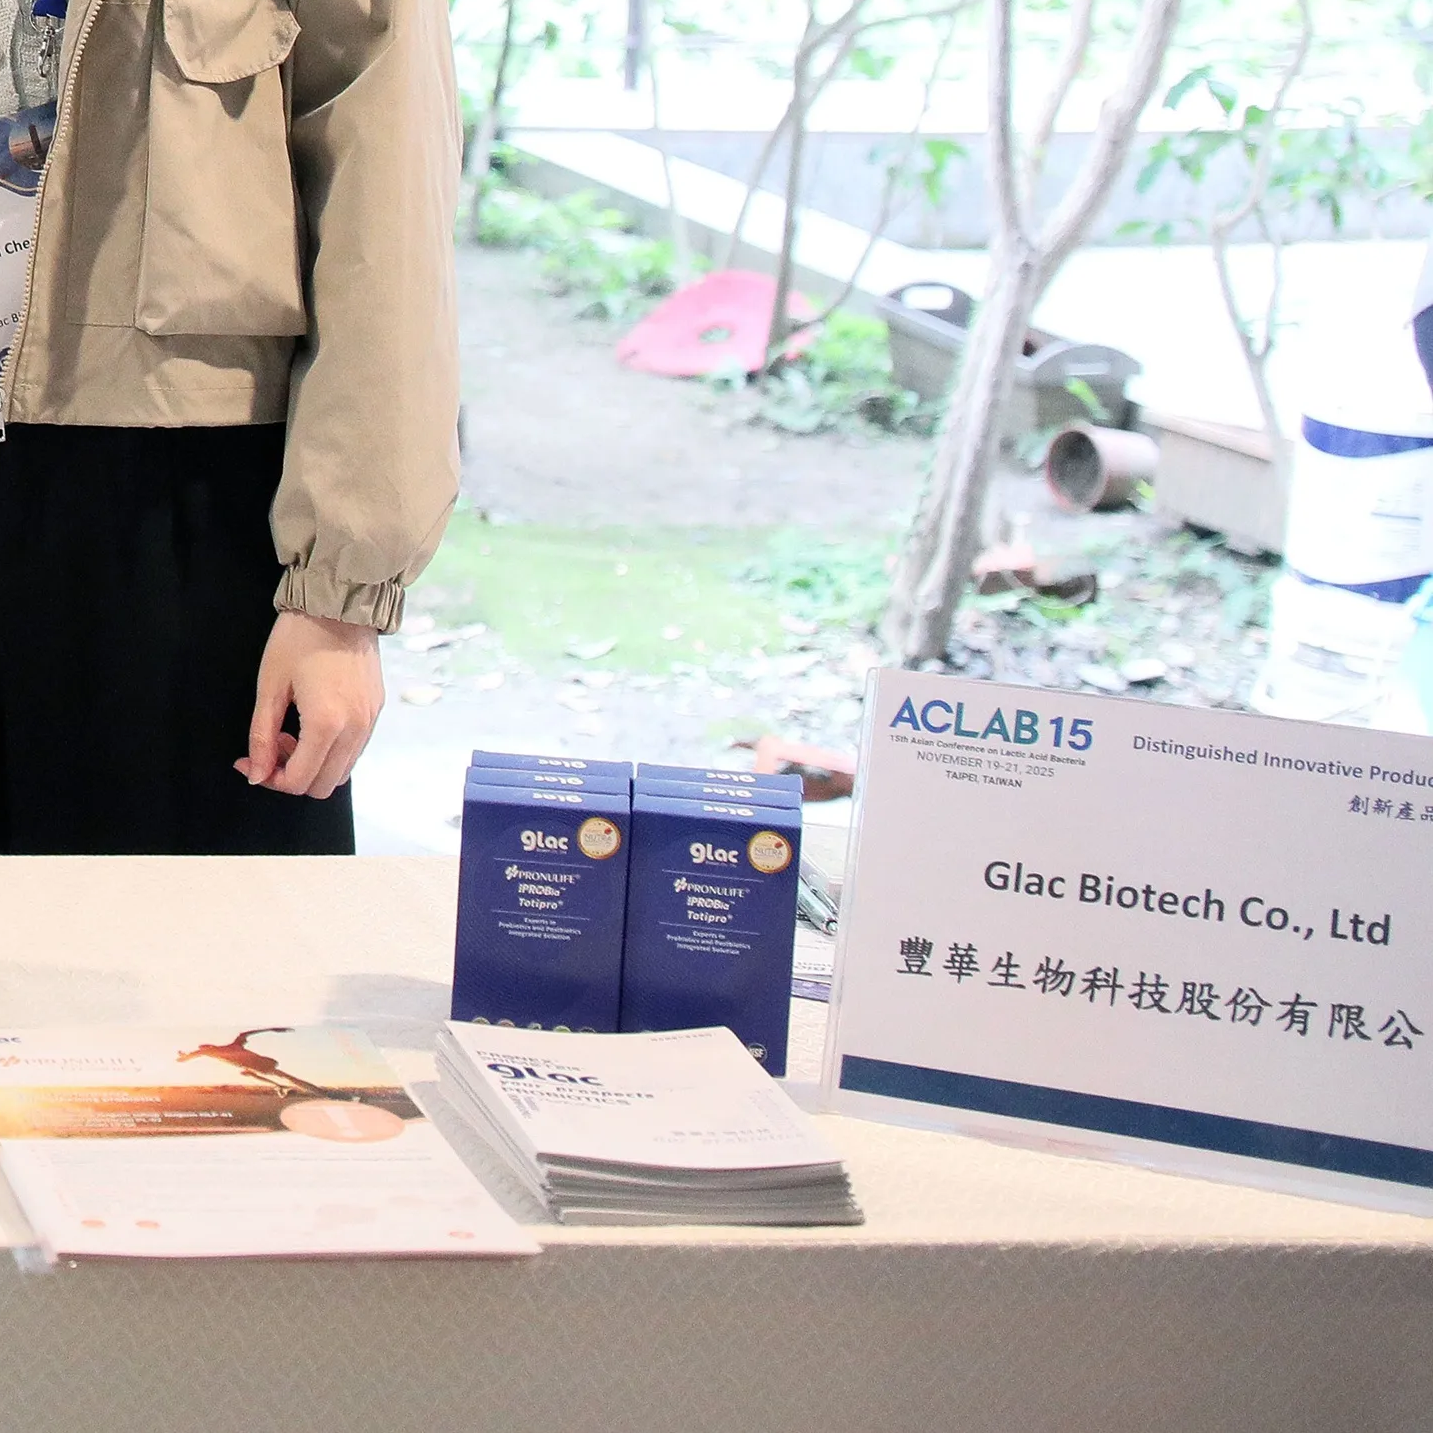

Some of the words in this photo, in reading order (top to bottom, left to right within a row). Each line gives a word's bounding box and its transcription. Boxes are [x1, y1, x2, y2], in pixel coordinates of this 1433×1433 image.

[5, 240, 30, 254] Che
[889, 696, 1039, 745] ACLAB
[1049, 716, 1094, 751] 15
[890, 735, 909, 744] 15th
[910, 737, 934, 746] Asian
[937, 740, 985, 753] Conference
[1001, 748, 1026, 758] Lactic
[1030, 752, 1048, 762] Acid
[1050, 755, 1086, 766] Bacteria
[1133, 736, 1258, 765] Distinguished
[1264, 752, 1364, 779] Innovative
[917, 751, 983, 768] NOVEMBER
[987, 760, 1022, 775] 19-21,
[1026, 765, 1055, 777] 2025
[983, 775, 1022, 788] TAIWAN
[520, 830, 569, 851] glac
[689, 842, 738, 864] glac
[983, 860, 1065, 900] Glac
[1079, 873, 1225, 922] Biotech
[1240, 896, 1314, 940] Co.,
[1331, 908, 1393, 946] Ltd
[896, 935, 1424, 1051] 豐華生物科技股份有限公
[487, 1062, 605, 1087] glac
